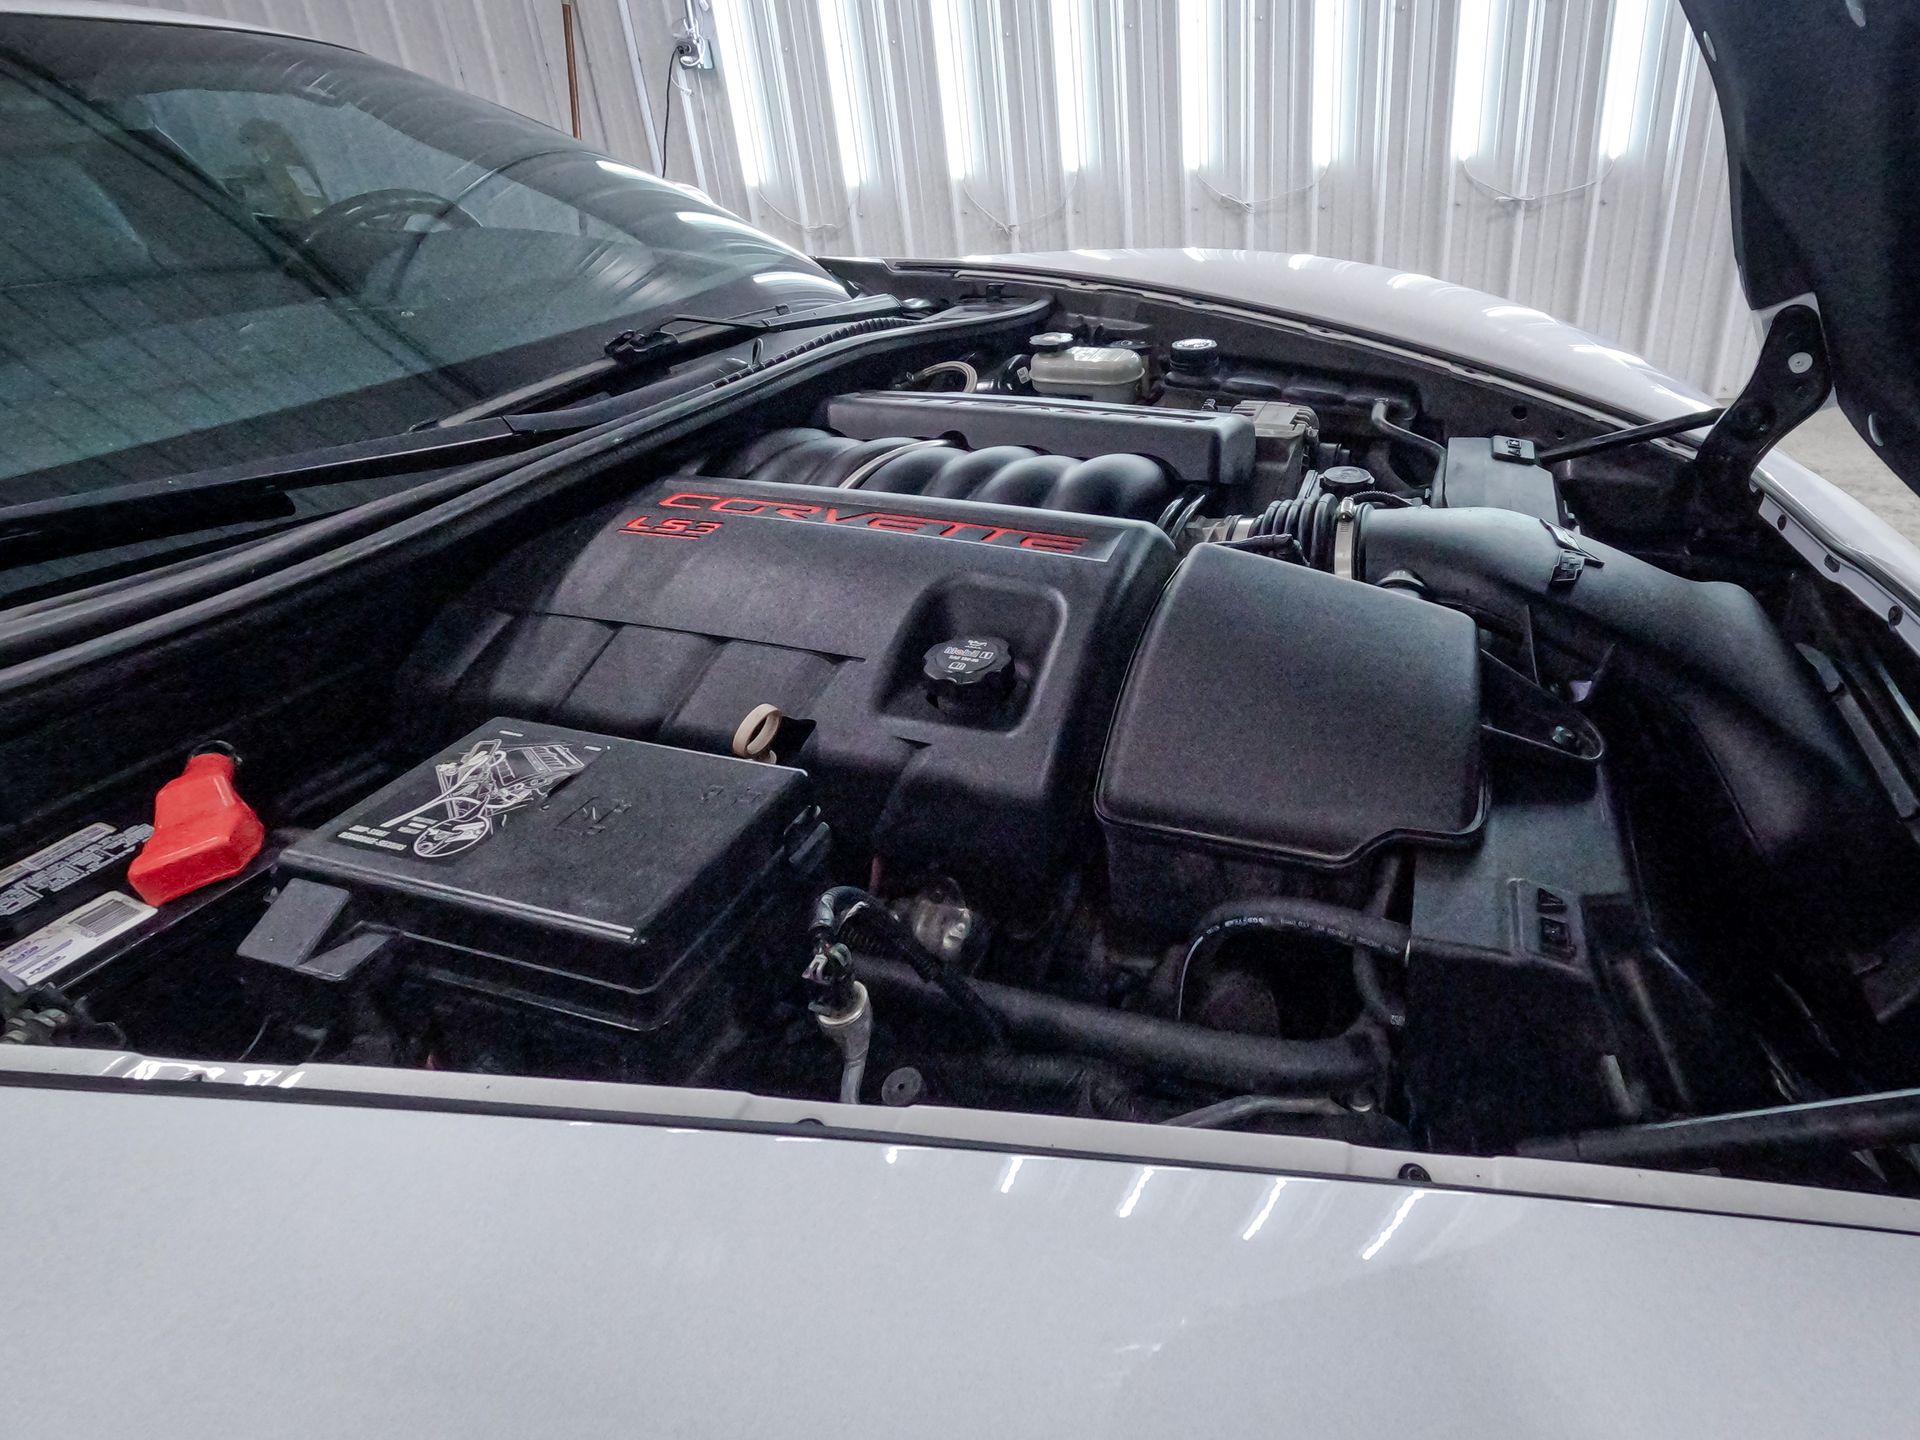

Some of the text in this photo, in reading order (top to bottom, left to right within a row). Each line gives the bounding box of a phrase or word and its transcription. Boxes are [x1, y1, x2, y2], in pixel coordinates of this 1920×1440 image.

[624, 514, 724, 537] LS3
[658, 491, 1088, 553] CORVETTE
[943, 647, 981, 658] Mobil
